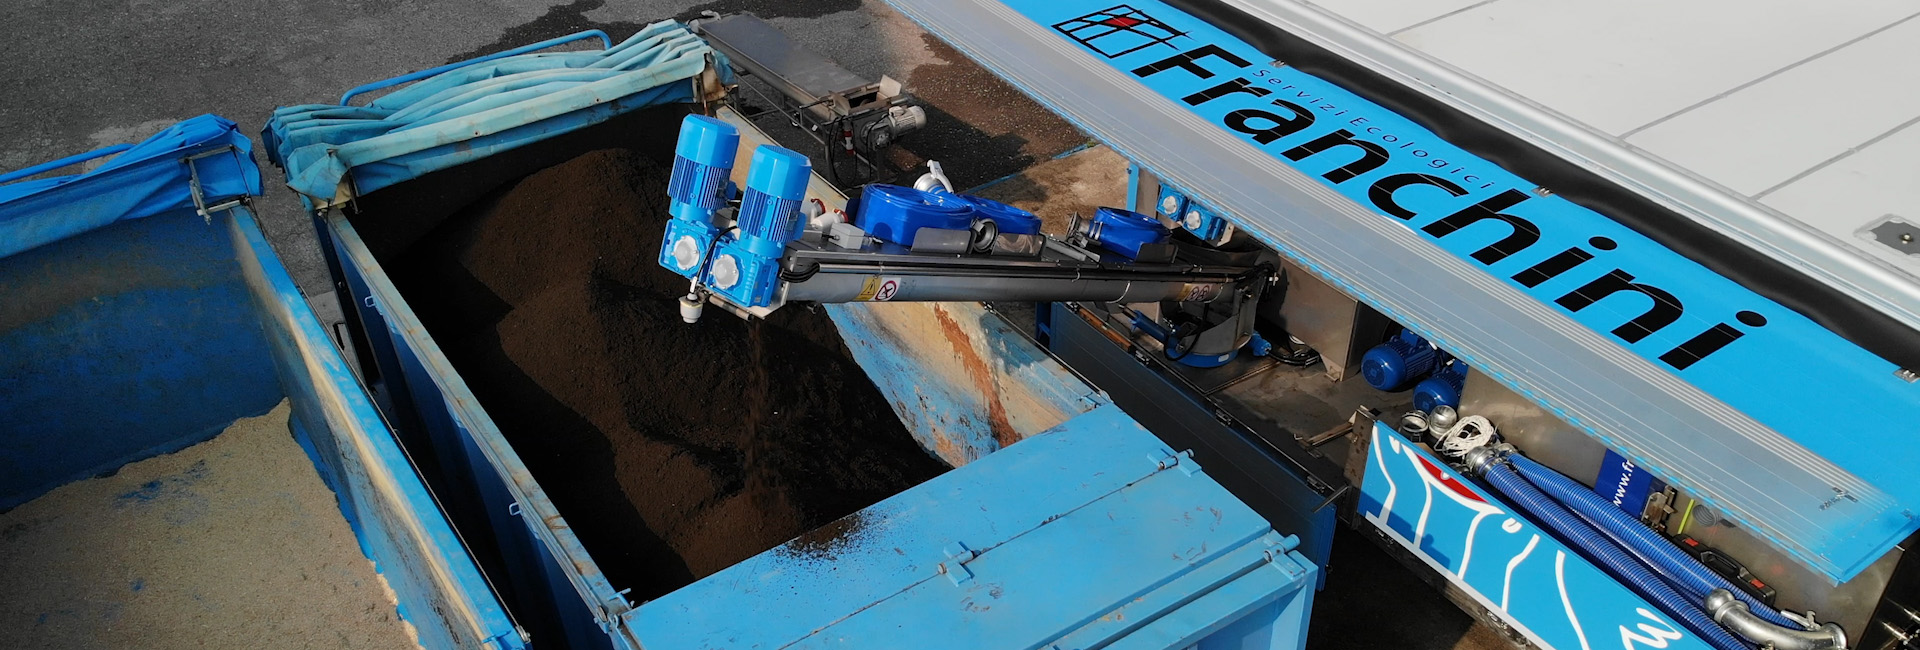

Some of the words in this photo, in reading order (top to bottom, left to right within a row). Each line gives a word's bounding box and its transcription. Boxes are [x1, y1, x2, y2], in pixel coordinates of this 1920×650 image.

[1131, 44, 1768, 371] Franchini
[1252, 69, 1349, 116] Servizi
[1349, 117, 1495, 189] Ecologici
